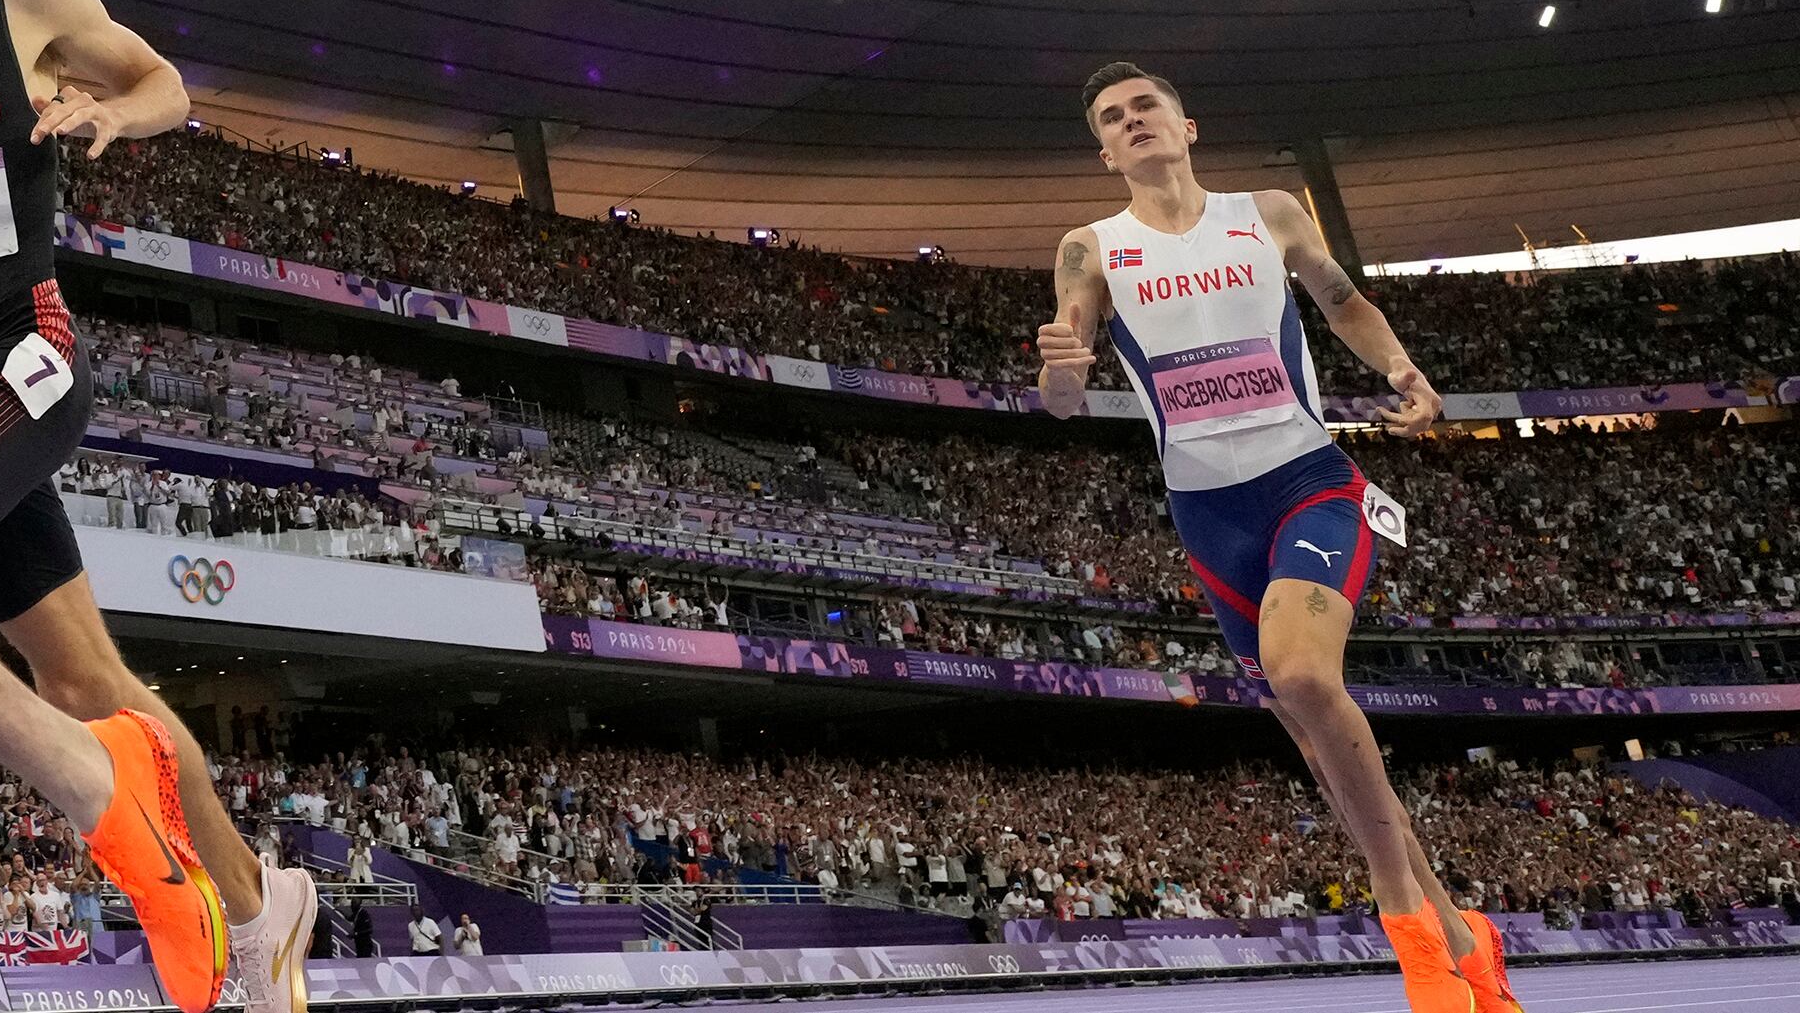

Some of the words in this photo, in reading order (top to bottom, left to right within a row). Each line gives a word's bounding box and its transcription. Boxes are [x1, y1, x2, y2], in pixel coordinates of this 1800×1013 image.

[220, 256, 270, 279] PARIS
[276, 268, 320, 290] 024
[1137, 263, 1256, 306] NORWAY
[1174, 350, 1207, 364] PARIS
[1210, 346, 1241, 357] 2024
[864, 377, 896, 392] ARIS
[900, 382, 930, 396] 202
[1160, 366, 1285, 413] INGEBRIGTSEN
[1557, 394, 1611, 409] PARIS
[570, 631, 592, 651] S13
[608, 631, 654, 651] PARIS
[657, 636, 697, 654] 2024
[850, 658, 870, 675] S12
[924, 659, 962, 676] PARIS
[964, 663, 997, 680] 2024
[1115, 675, 1149, 691] PARIS
[1366, 692, 1402, 706] PARIS
[1404, 693, 1439, 707] 2024
[1690, 692, 1735, 706] PARIS
[1739, 691, 1782, 705] 2024
[539, 974, 583, 991] PARIS
[586, 973, 629, 990] 2024
[22, 990, 88, 1012] PARIS
[94, 988, 151, 1009] 2024
